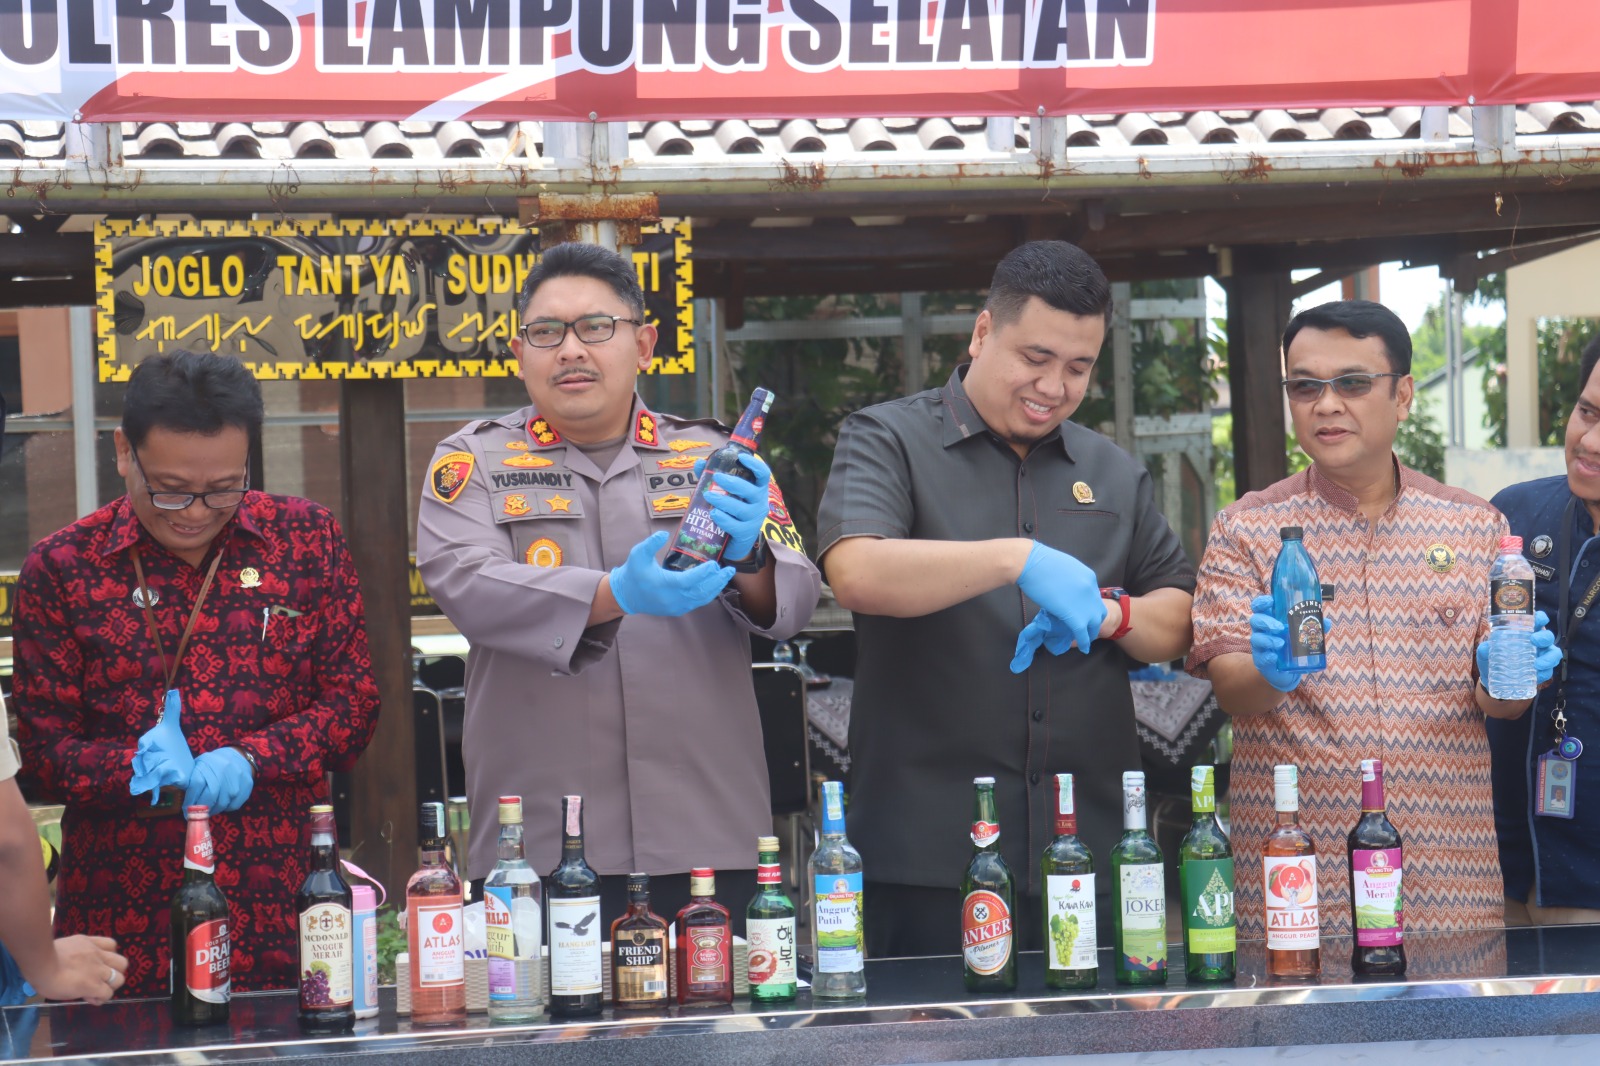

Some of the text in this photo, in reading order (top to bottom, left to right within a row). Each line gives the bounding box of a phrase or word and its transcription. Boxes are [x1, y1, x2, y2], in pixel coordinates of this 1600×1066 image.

[322, 0, 761, 66] LAMPUNG
[788, 0, 1149, 65] SELATAN
[132, 255, 245, 297] JOGLO
[277, 254, 411, 296] TANTYA
[492, 471, 562, 489] YUSRIANDI
[650, 472, 699, 490] POL
[685, 513, 726, 538] HITAM
[974, 830, 993, 841] ANKER
[1362, 880, 1397, 889] Anggur
[1366, 889, 1396, 899] Merah
[817, 905, 851, 915] Anggur
[1125, 898, 1165, 916] JOKER
[1192, 891, 1235, 917] API
[818, 915, 843, 925] Putih
[1270, 912, 1316, 927] ATLAS
[963, 917, 1012, 947] ANKER
[1299, 931, 1317, 939] PEACH
[311, 942, 344, 952] ANGGUR
[424, 934, 461, 949] ATLAS
[312, 951, 343, 960] MERAH
[618, 945, 661, 957] FRIEND
[626, 956, 654, 966] SHIP
